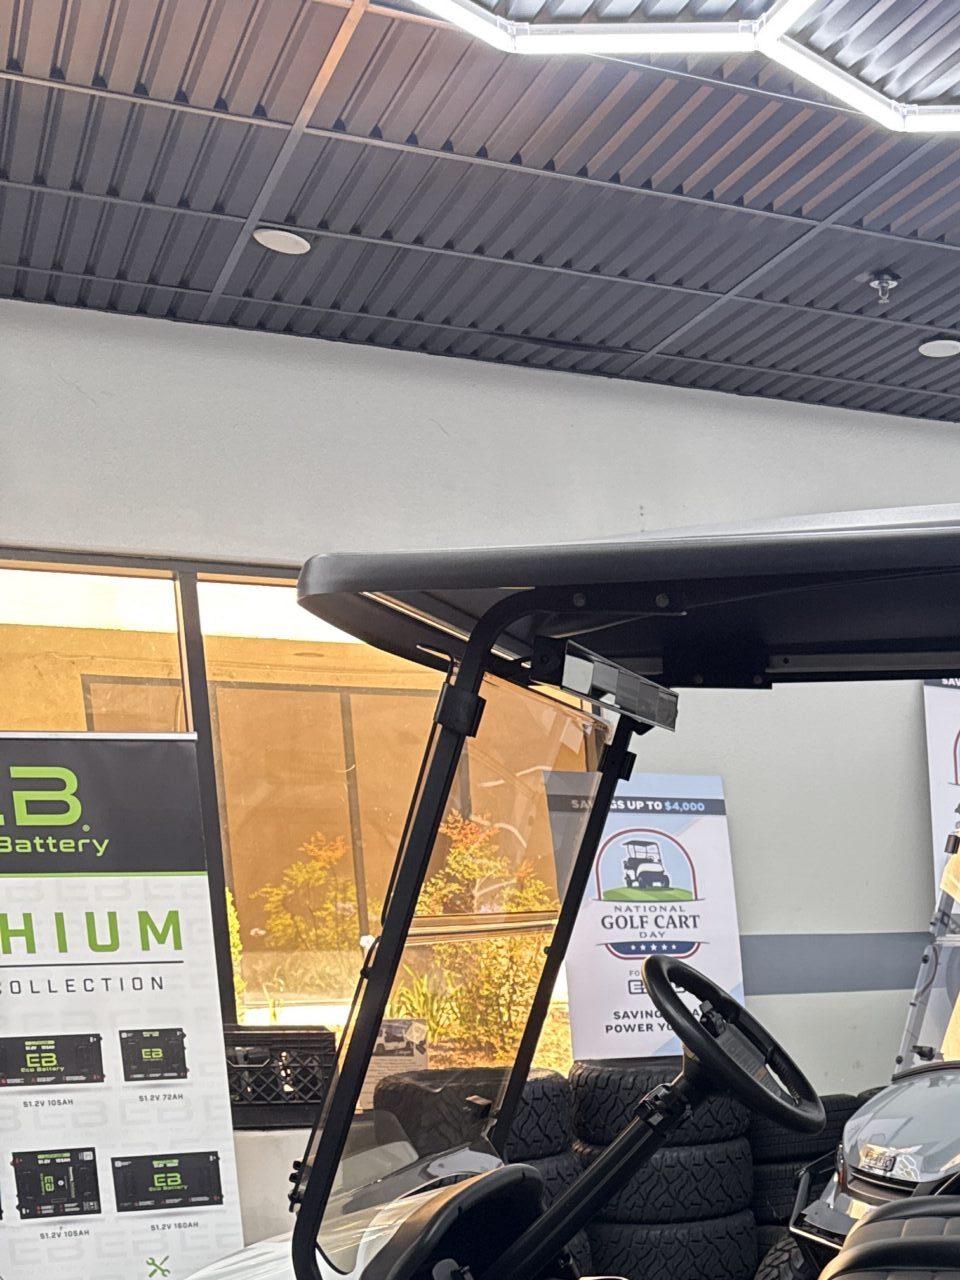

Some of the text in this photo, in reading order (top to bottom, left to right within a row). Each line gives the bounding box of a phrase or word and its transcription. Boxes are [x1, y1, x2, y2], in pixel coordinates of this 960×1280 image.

[0, 766, 82, 826] B
[627, 800, 644, 810] UP
[646, 801, 662, 811] TO
[664, 802, 705, 812] $4,000
[0, 836, 109, 856] Battery
[601, 915, 700, 929] GOLF CART
[0, 976, 163, 994] OLLECTION
[613, 1010, 663, 1020] SAVING
[605, 1023, 654, 1034] POWER
[142, 1048, 163, 1058] EB
[26, 1053, 57, 1067] EB
[153, 1173, 181, 1186] EB
